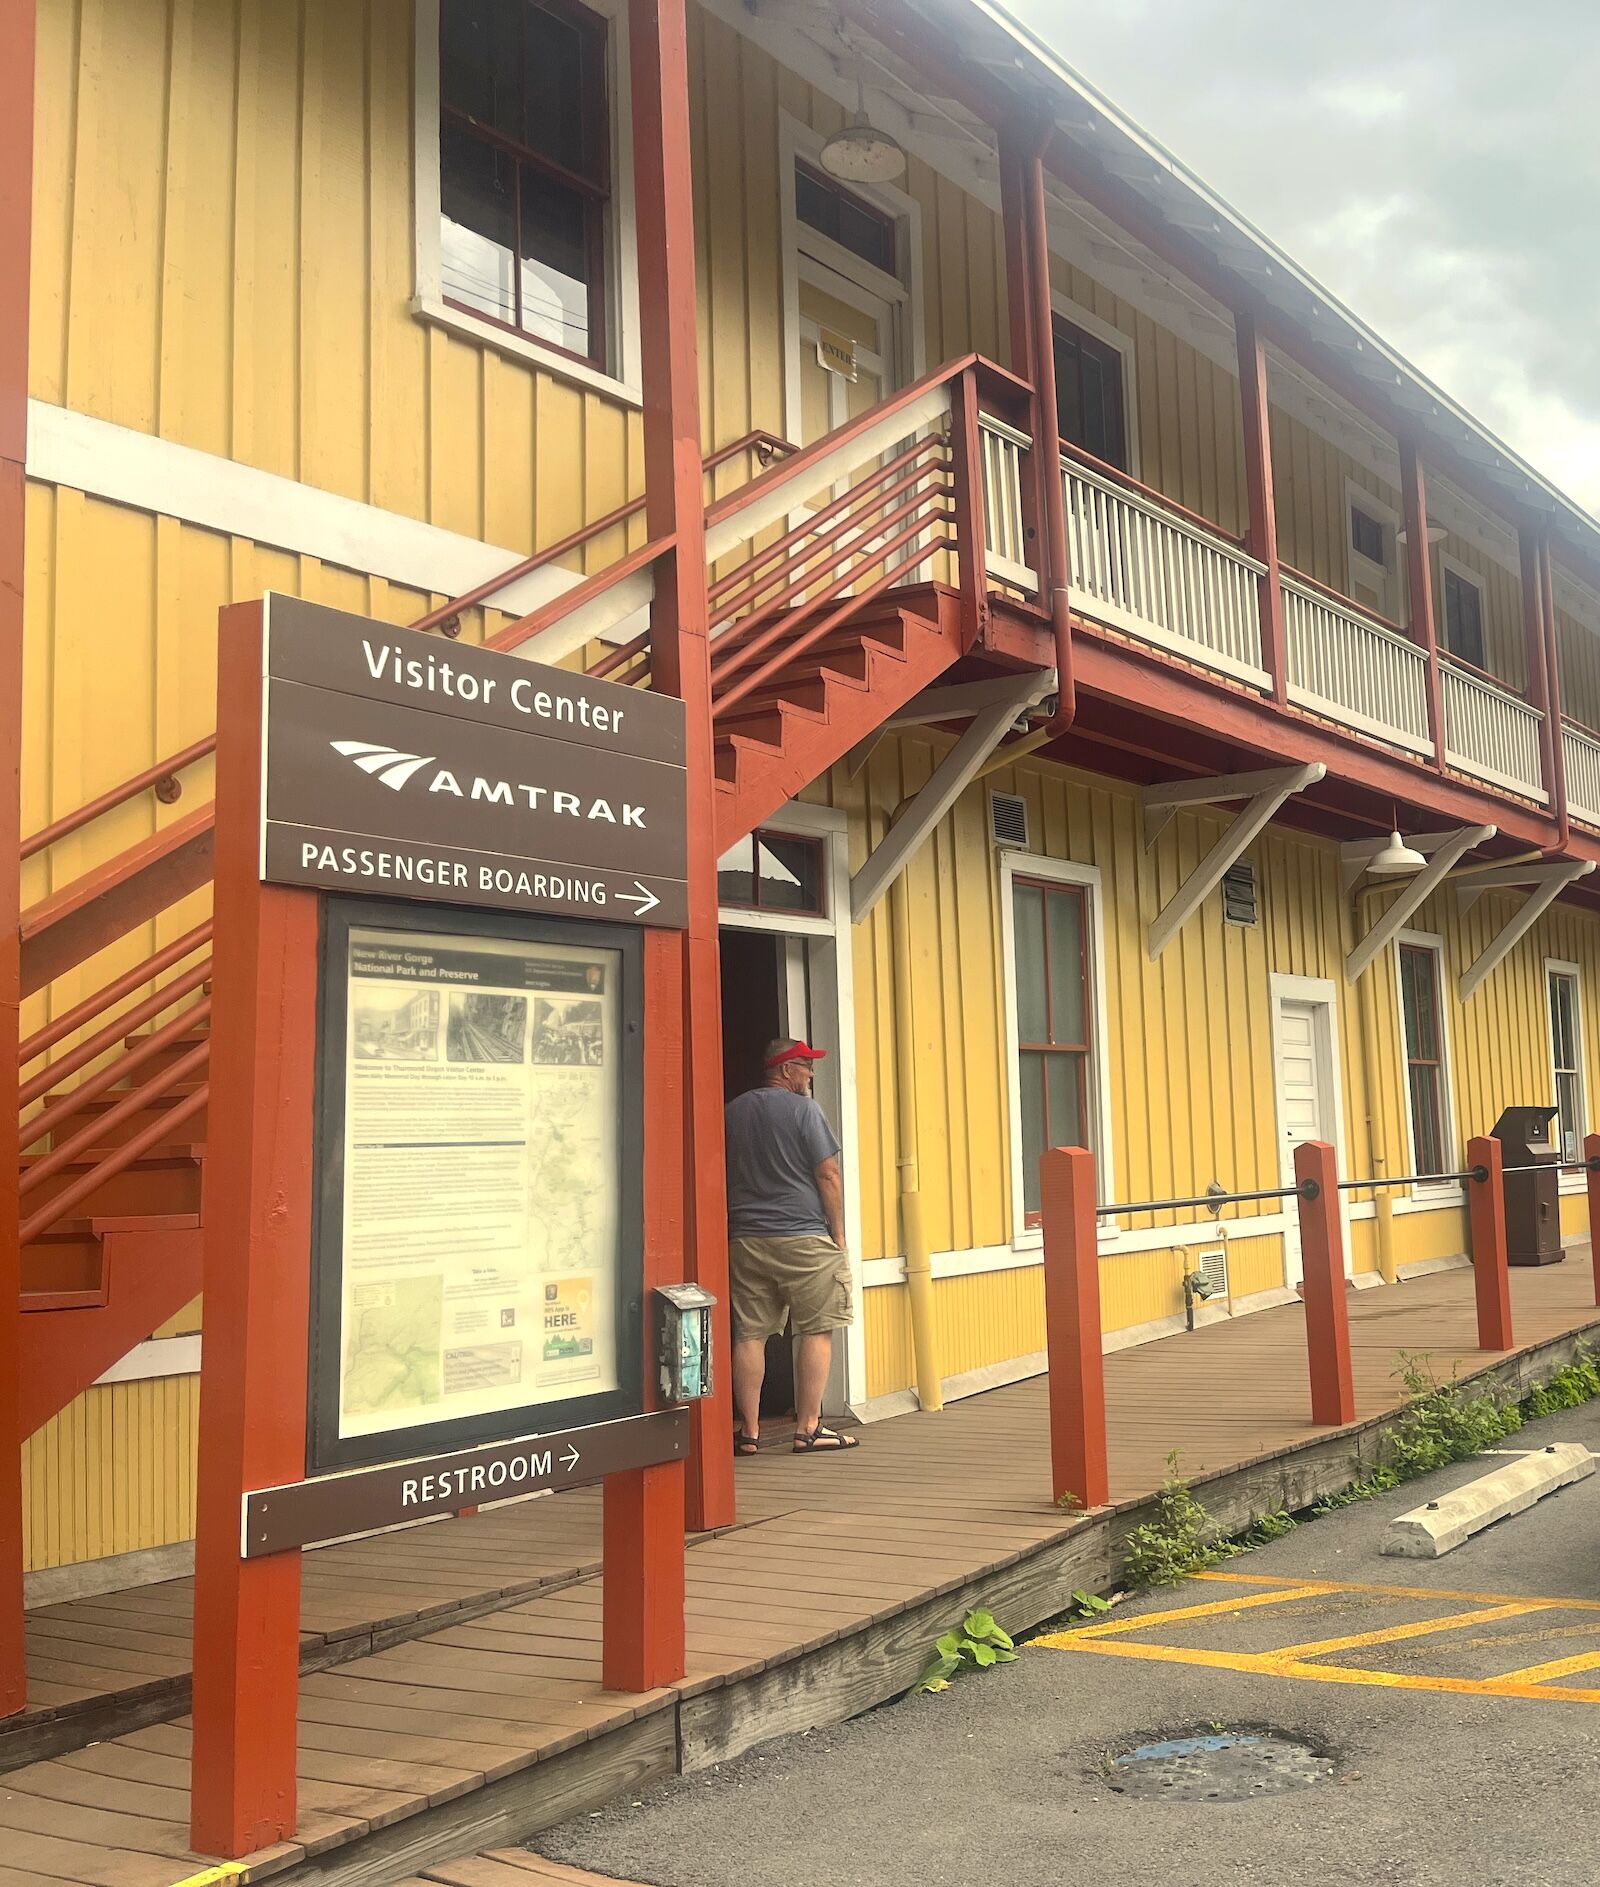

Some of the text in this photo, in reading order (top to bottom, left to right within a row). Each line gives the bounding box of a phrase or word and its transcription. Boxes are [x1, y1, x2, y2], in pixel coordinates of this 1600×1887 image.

[362, 639, 625, 734] Visitor Center
[428, 770, 648, 829] AMTRAK
[302, 842, 606, 905] PASSENGER BOARDING
[353, 948, 433, 965] New River Gorge
[354, 961, 479, 980] National Park and Preserve
[544, 1313, 577, 1328] HERE
[402, 1450, 552, 1507] RESTROOM
